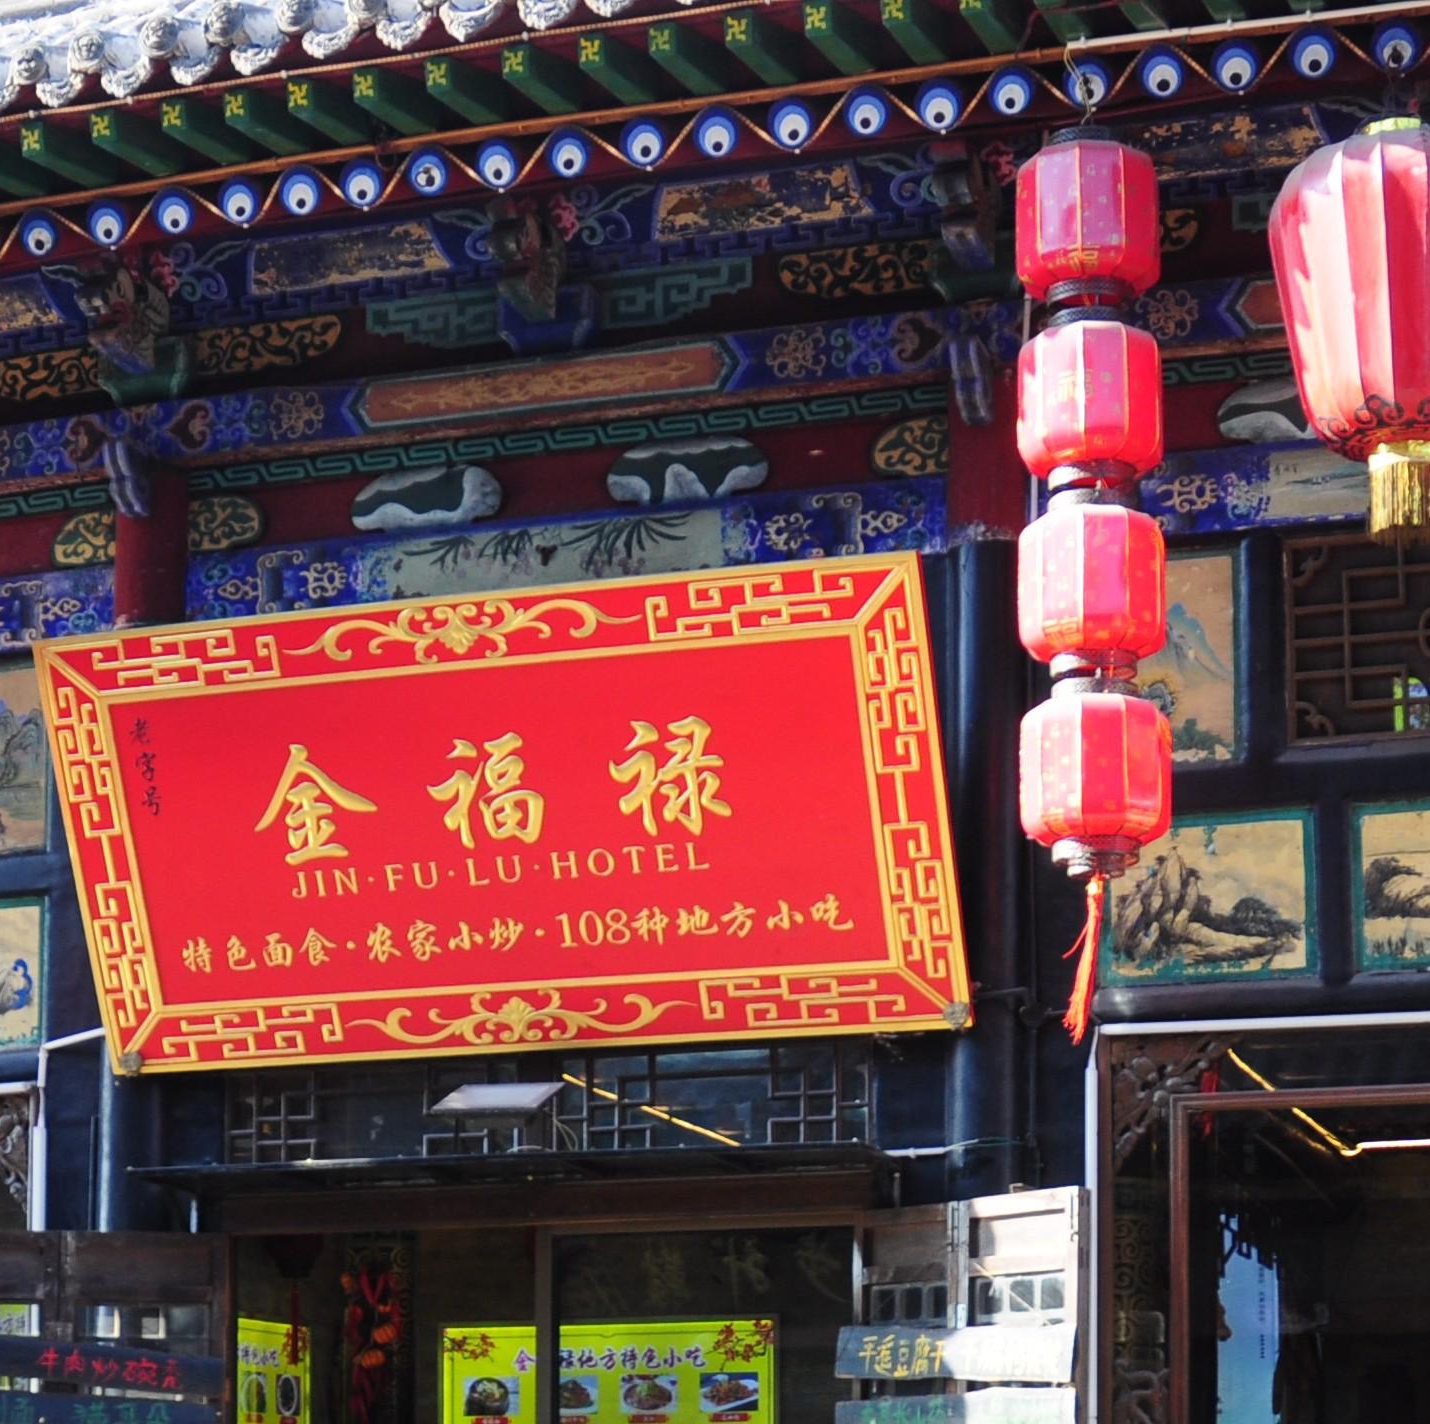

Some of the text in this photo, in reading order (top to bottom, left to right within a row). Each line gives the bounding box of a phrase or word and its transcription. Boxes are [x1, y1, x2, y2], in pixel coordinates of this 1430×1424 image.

[128, 716, 162, 817] 老字号
[253, 714, 734, 867] 金福禄
